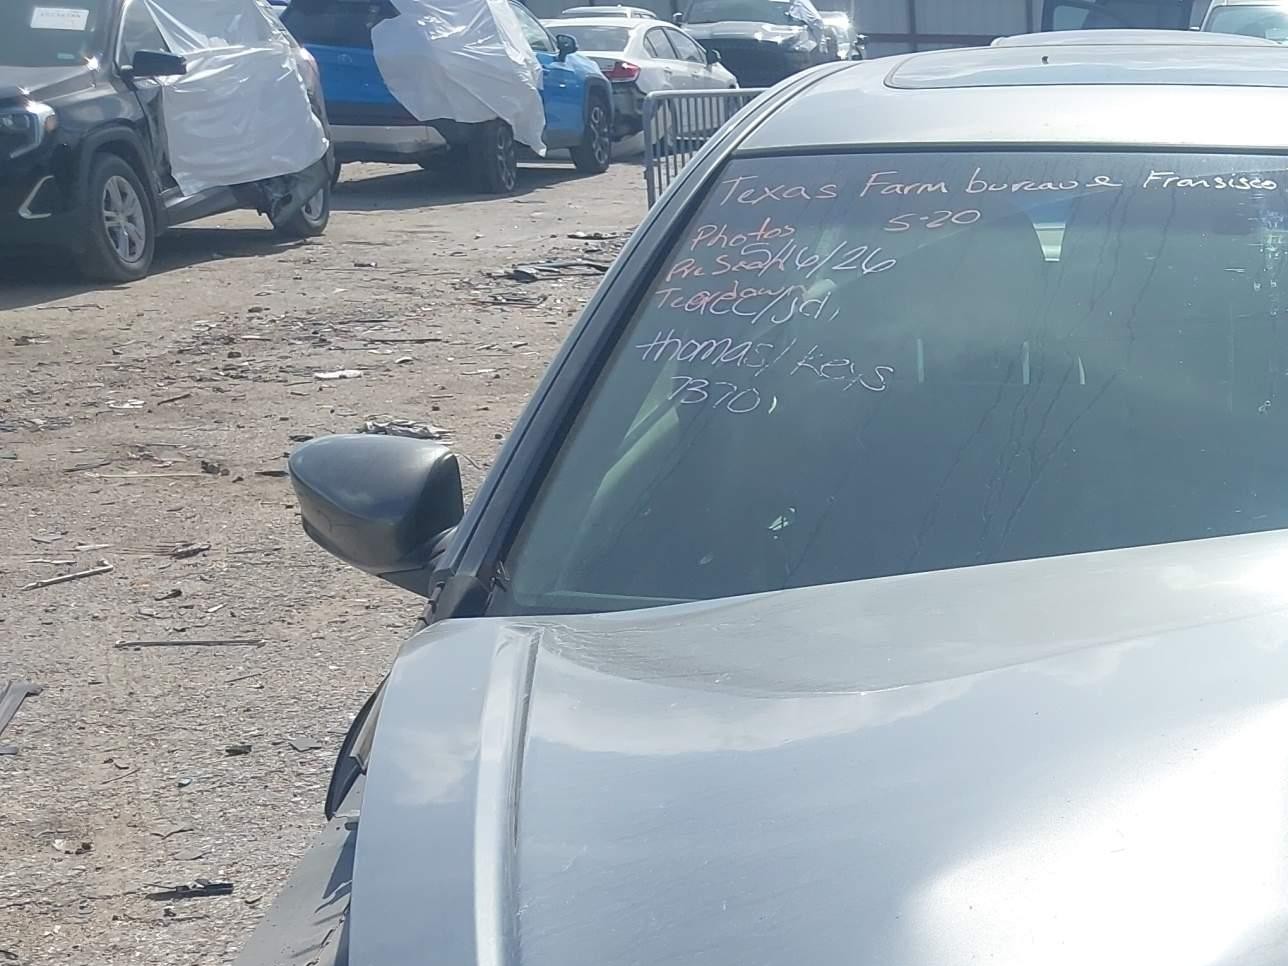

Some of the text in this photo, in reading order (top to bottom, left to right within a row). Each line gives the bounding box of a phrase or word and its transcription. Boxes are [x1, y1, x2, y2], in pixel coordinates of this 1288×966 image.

[720, 175, 838, 206] Texas
[859, 170, 949, 197] Farm
[689, 217, 796, 251] Photos
